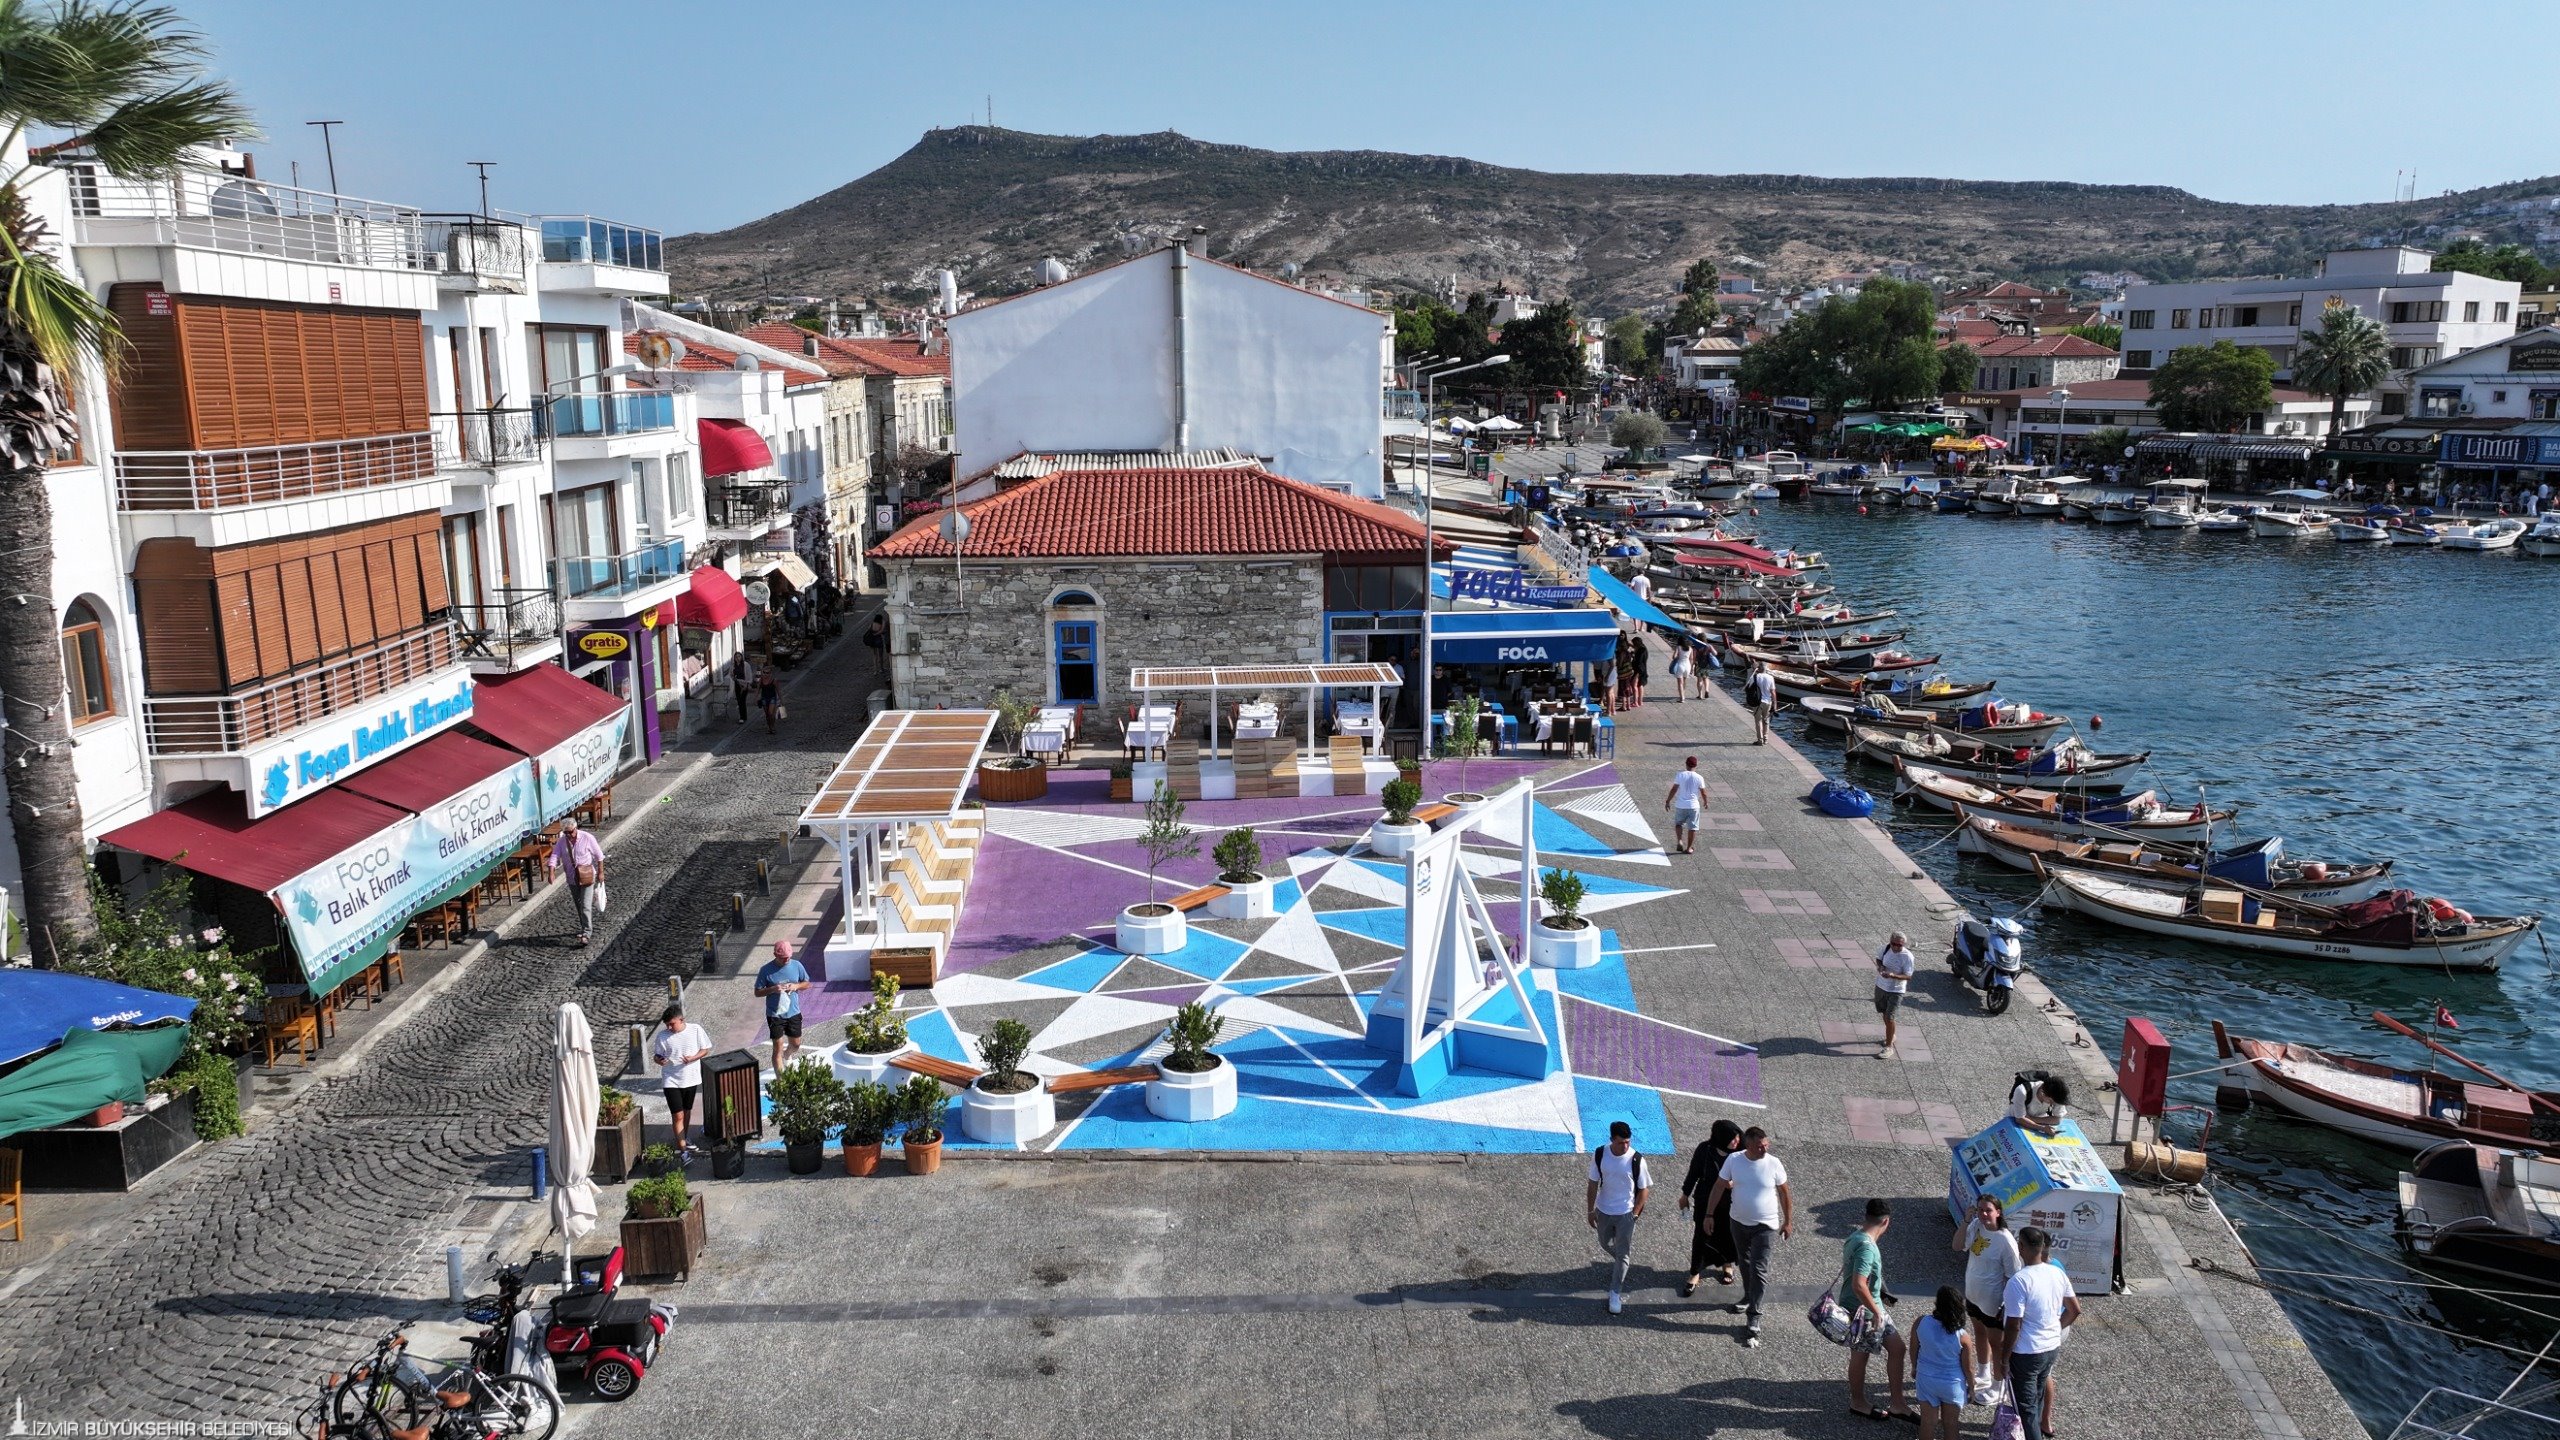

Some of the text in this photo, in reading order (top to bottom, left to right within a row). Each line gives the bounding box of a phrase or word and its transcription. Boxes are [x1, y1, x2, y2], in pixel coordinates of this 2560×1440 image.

[1452, 569, 1586, 608] FOÇA Restaurant
[585, 636, 621, 650] gratis
[1498, 646, 1548, 660] FOÇA
[296, 681, 475, 788] Foça Balık Ekmek
[448, 792, 491, 828] Foça
[439, 805, 508, 859] Balık Ekmek
[336, 845, 390, 889] Foça
[327, 888, 370, 925] Balık
[369, 861, 412, 901] Ekmek
[2302, 890, 2340, 898] KAYAR
